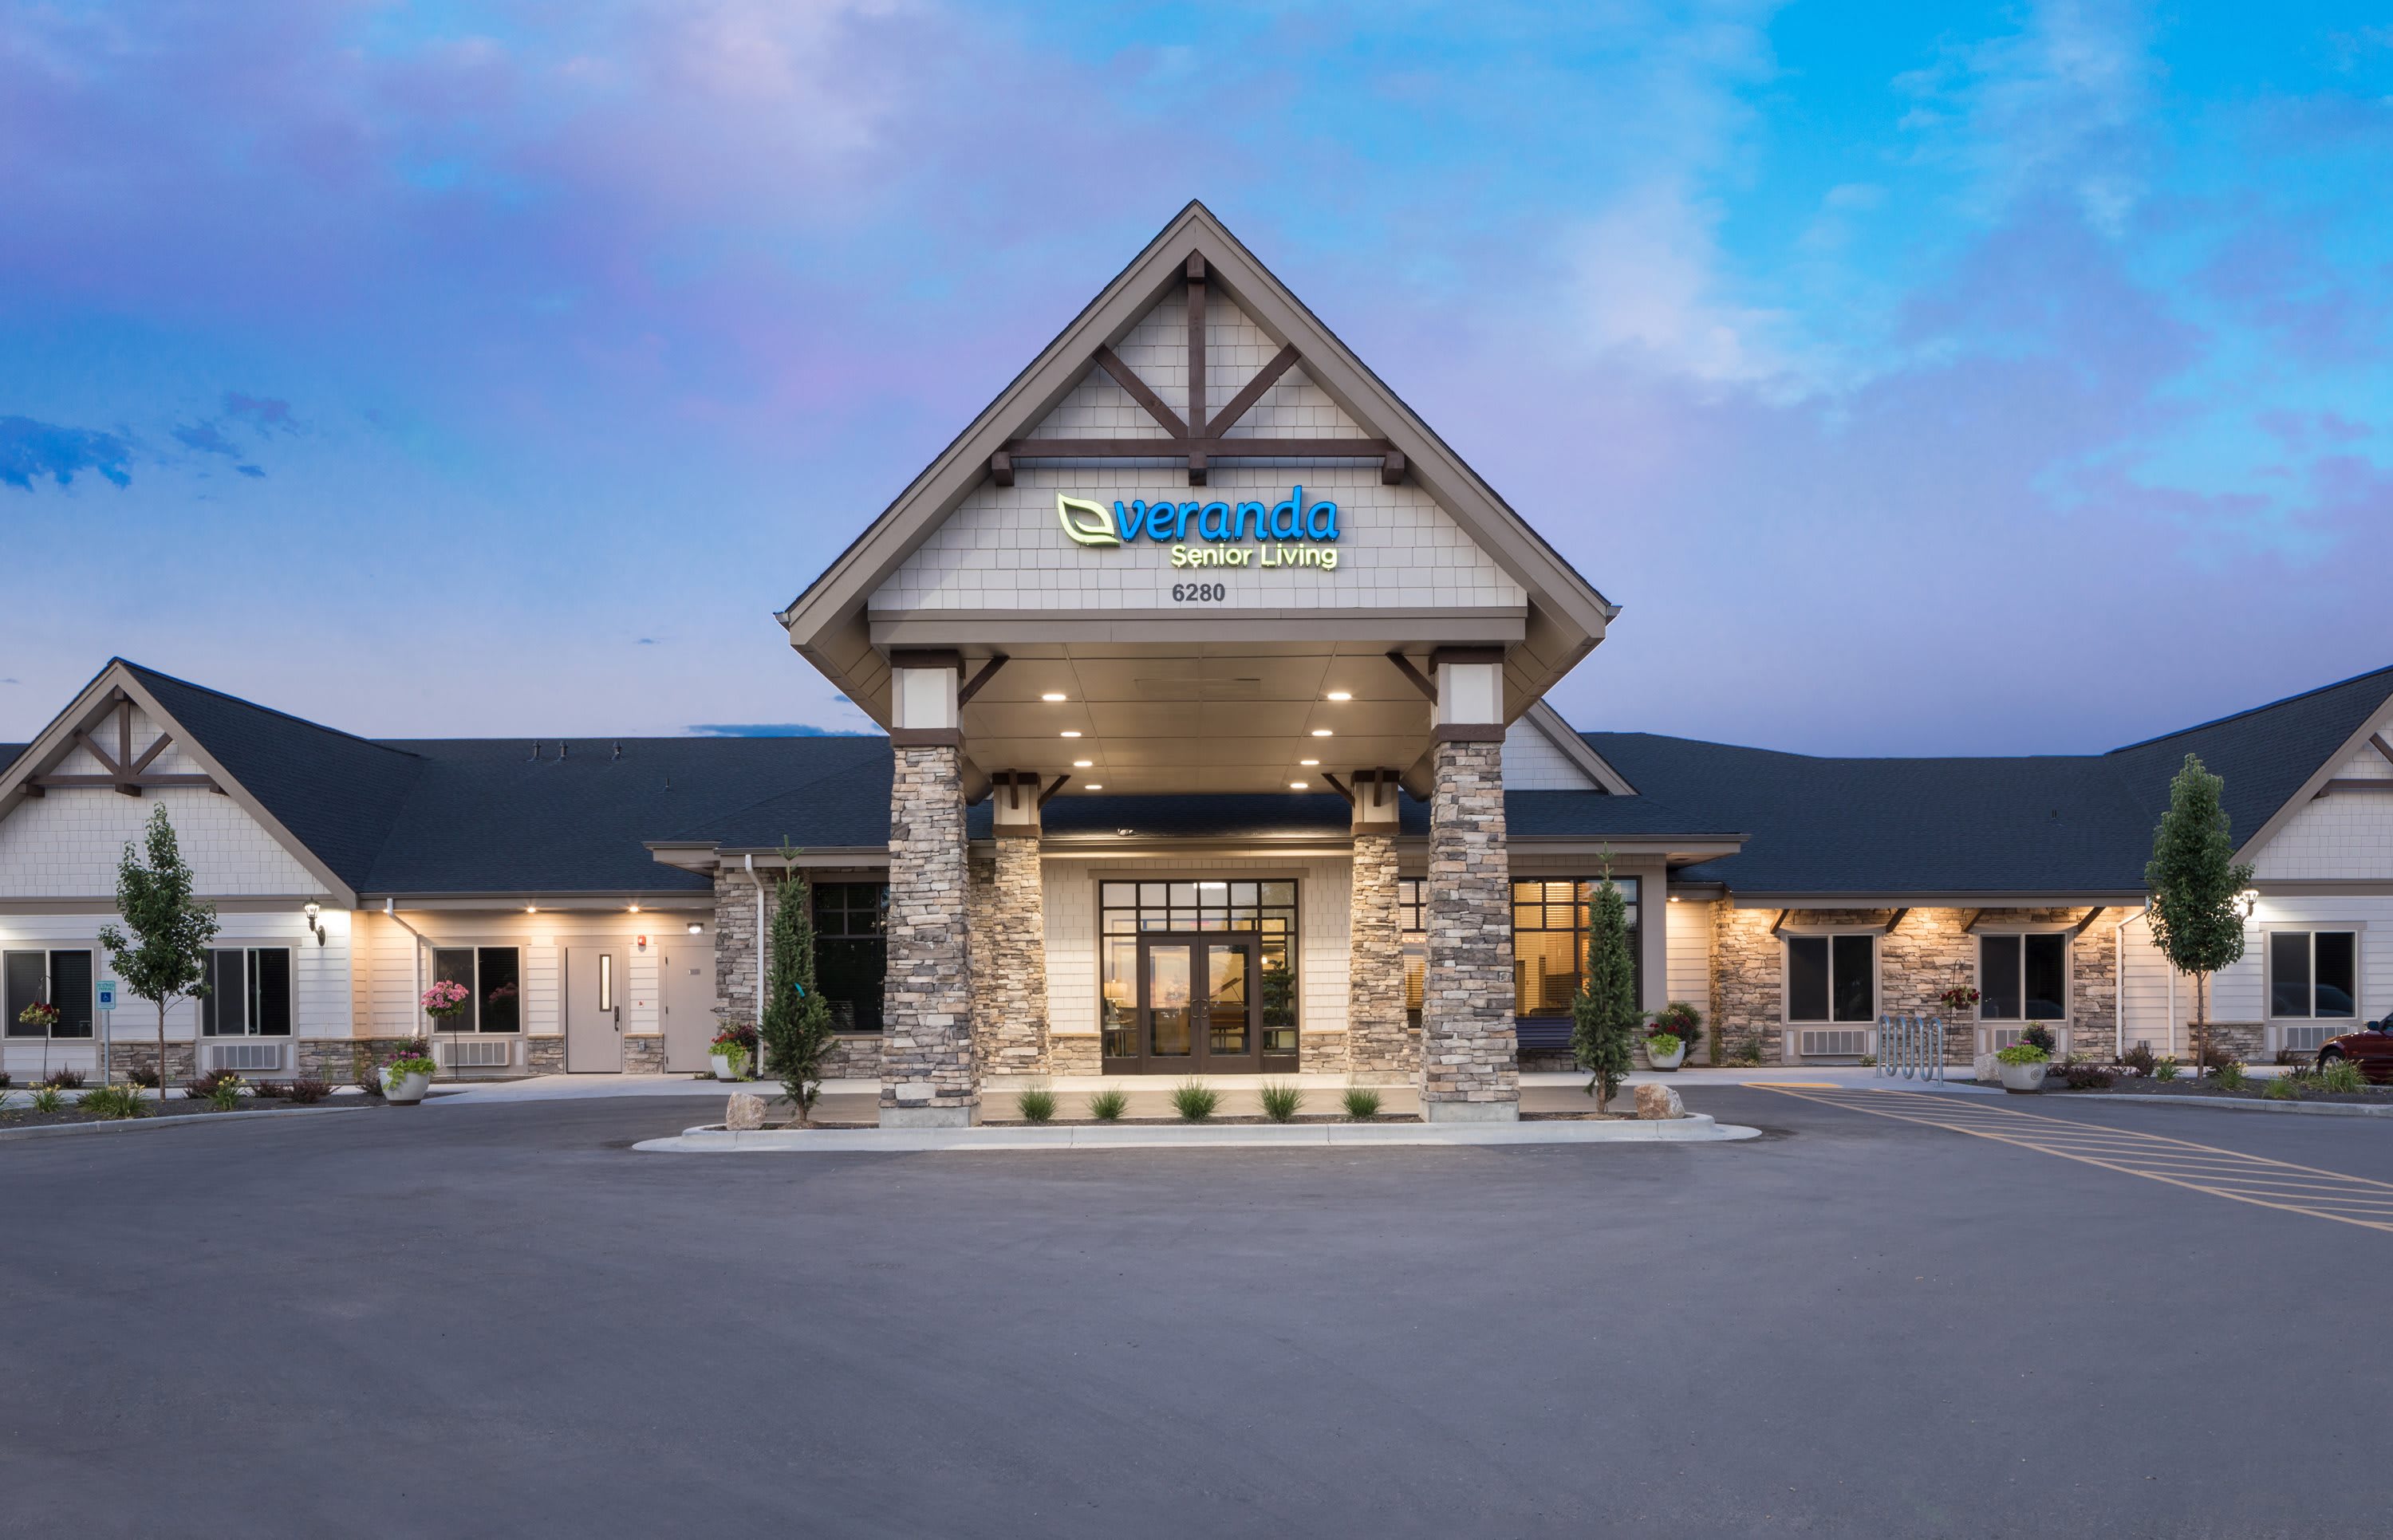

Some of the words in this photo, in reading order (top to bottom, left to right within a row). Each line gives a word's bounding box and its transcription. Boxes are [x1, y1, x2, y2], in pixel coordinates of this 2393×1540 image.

[1114, 485, 1339, 542] veranda
[1172, 543, 1252, 567] Senior
[1261, 543, 1338, 571] Living
[1173, 583, 1225, 602] 6280
